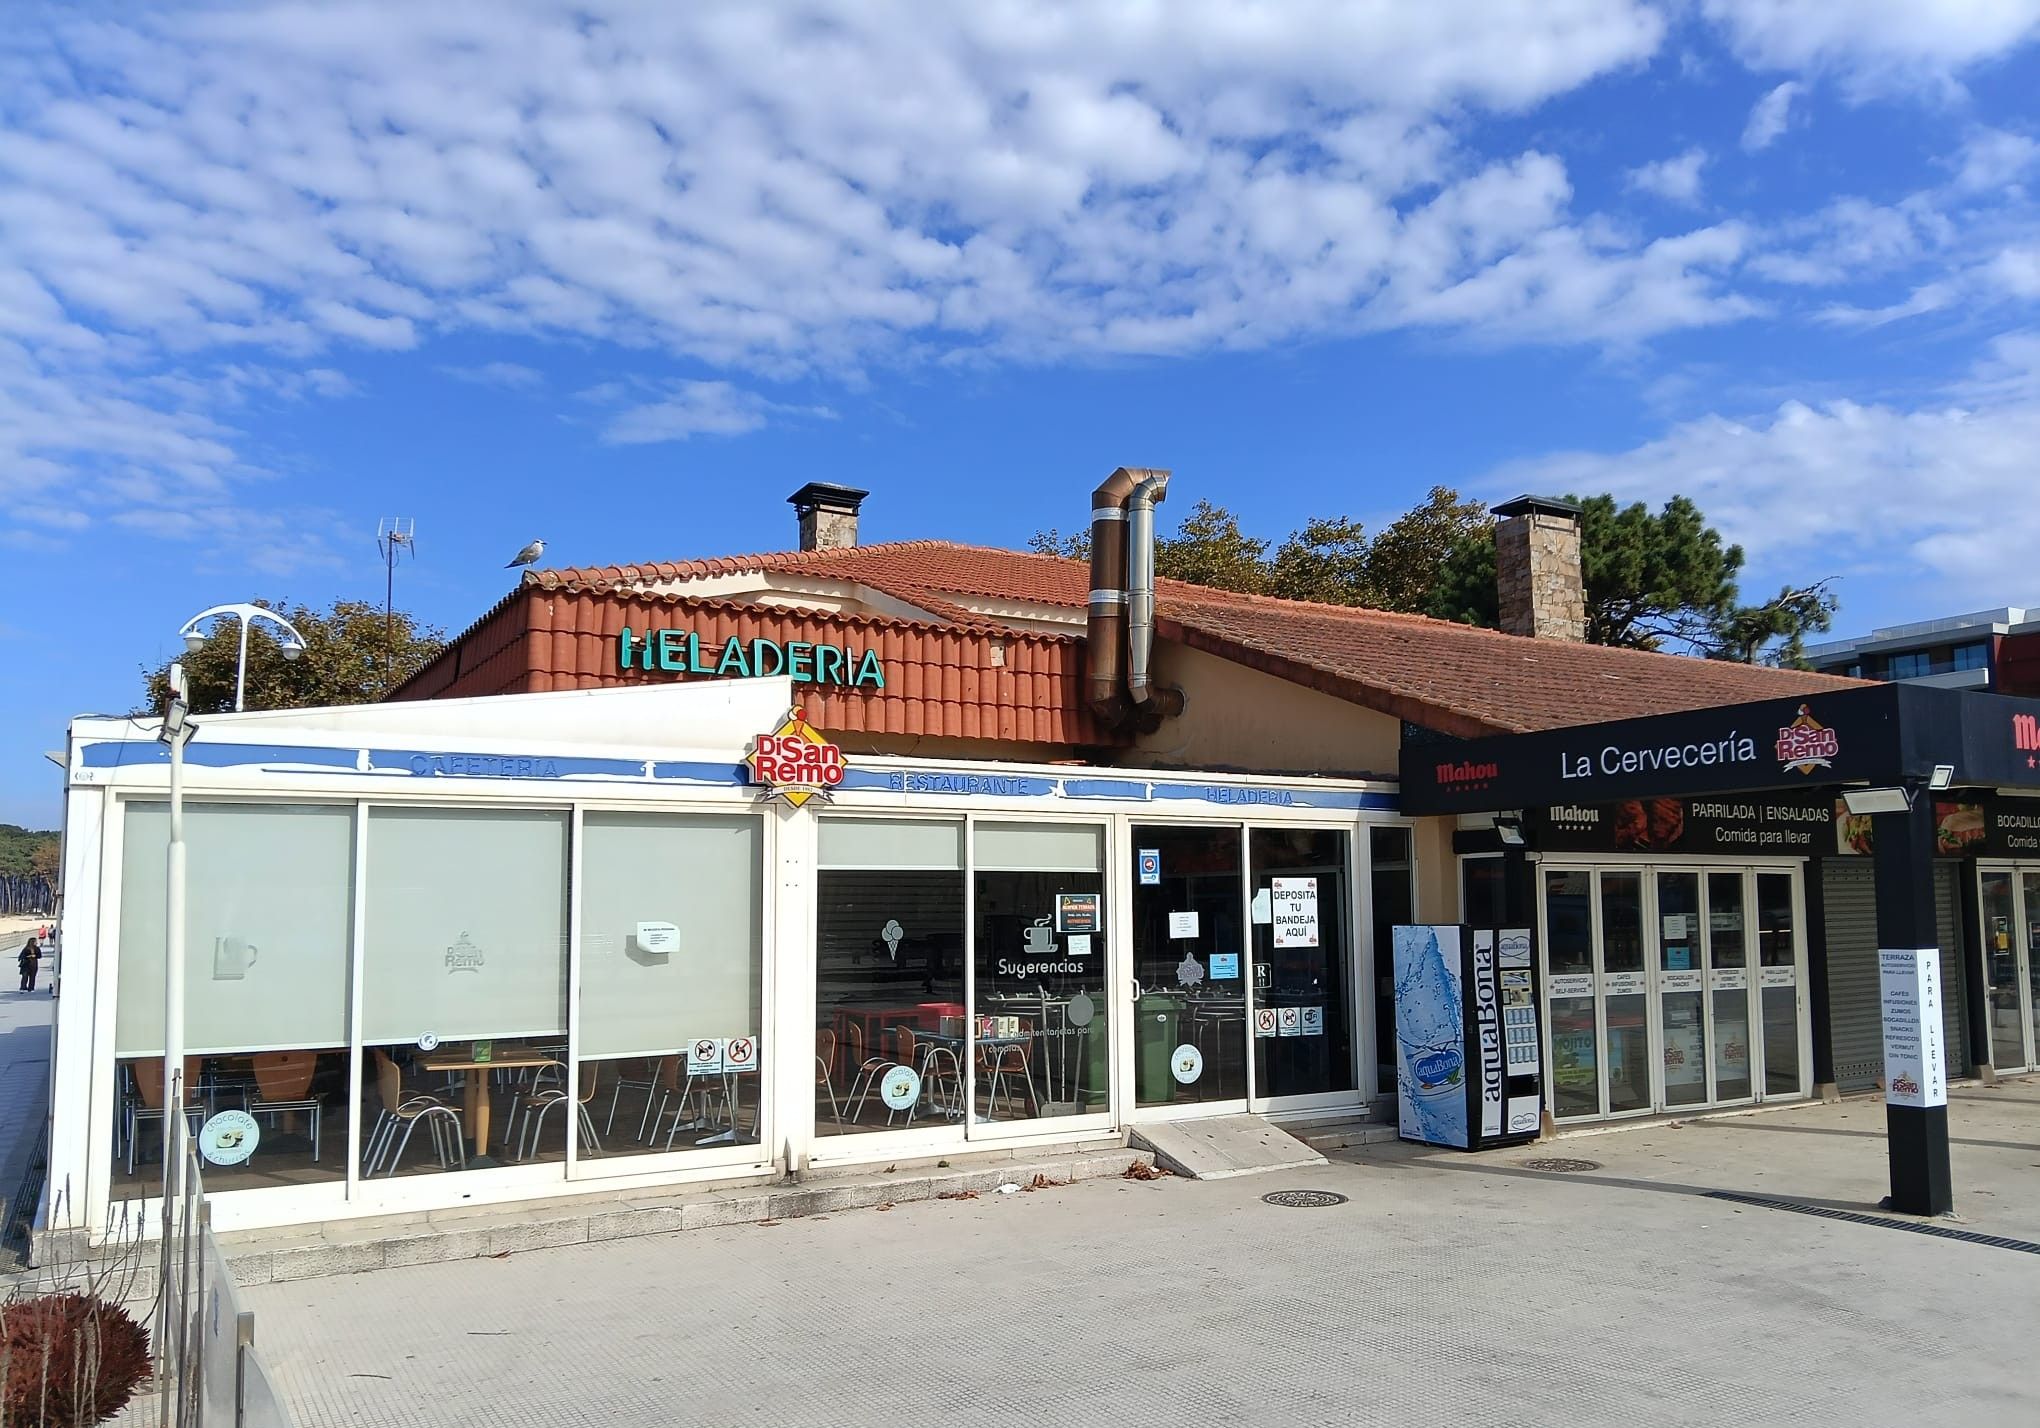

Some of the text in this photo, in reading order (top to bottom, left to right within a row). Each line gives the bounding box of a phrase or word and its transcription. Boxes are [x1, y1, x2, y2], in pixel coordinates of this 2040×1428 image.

[620, 626, 886, 689] HELADERIA
[2012, 713, 2040, 751] M
[1561, 730, 1757, 779] La Cervecería
[1776, 740, 1839, 761] Remo
[409, 754, 561, 778] CAFETERIA
[756, 756, 843, 784] Remo
[1436, 761, 1499, 785] Mahou
[889, 772, 1029, 796] RESTAURANTE
[1550, 804, 1600, 823] Mahou
[1692, 802, 1830, 823] PARRILADA ENSALADAS
[1715, 826, 1811, 846] Comida para llevar
[2007, 834, 2038, 849] Comida
[1274, 890, 1316, 900] DEPOSITA
[1289, 903, 1302, 912] TU
[1276, 915, 1316, 925] BANDEJA
[1285, 925, 1308, 937] AQUÍ
[1881, 953, 1915, 961] TERRAZA
[998, 957, 1085, 979] Sugerencias
[1883, 999, 1918, 1007] INFUSIONES
[1476, 943, 1501, 1103] aquaBona
[1926, 961, 1939, 1097] PARA LLEVAR
[1012, 1028, 1045, 1039] admten
[1553, 1035, 1592, 1052] MOJITO
[988, 1044, 1022, 1056] compras
[1417, 1055, 1460, 1078] aquaBona
[1892, 1084, 1919, 1095] Remo
[206, 1113, 254, 1133] chocolate
